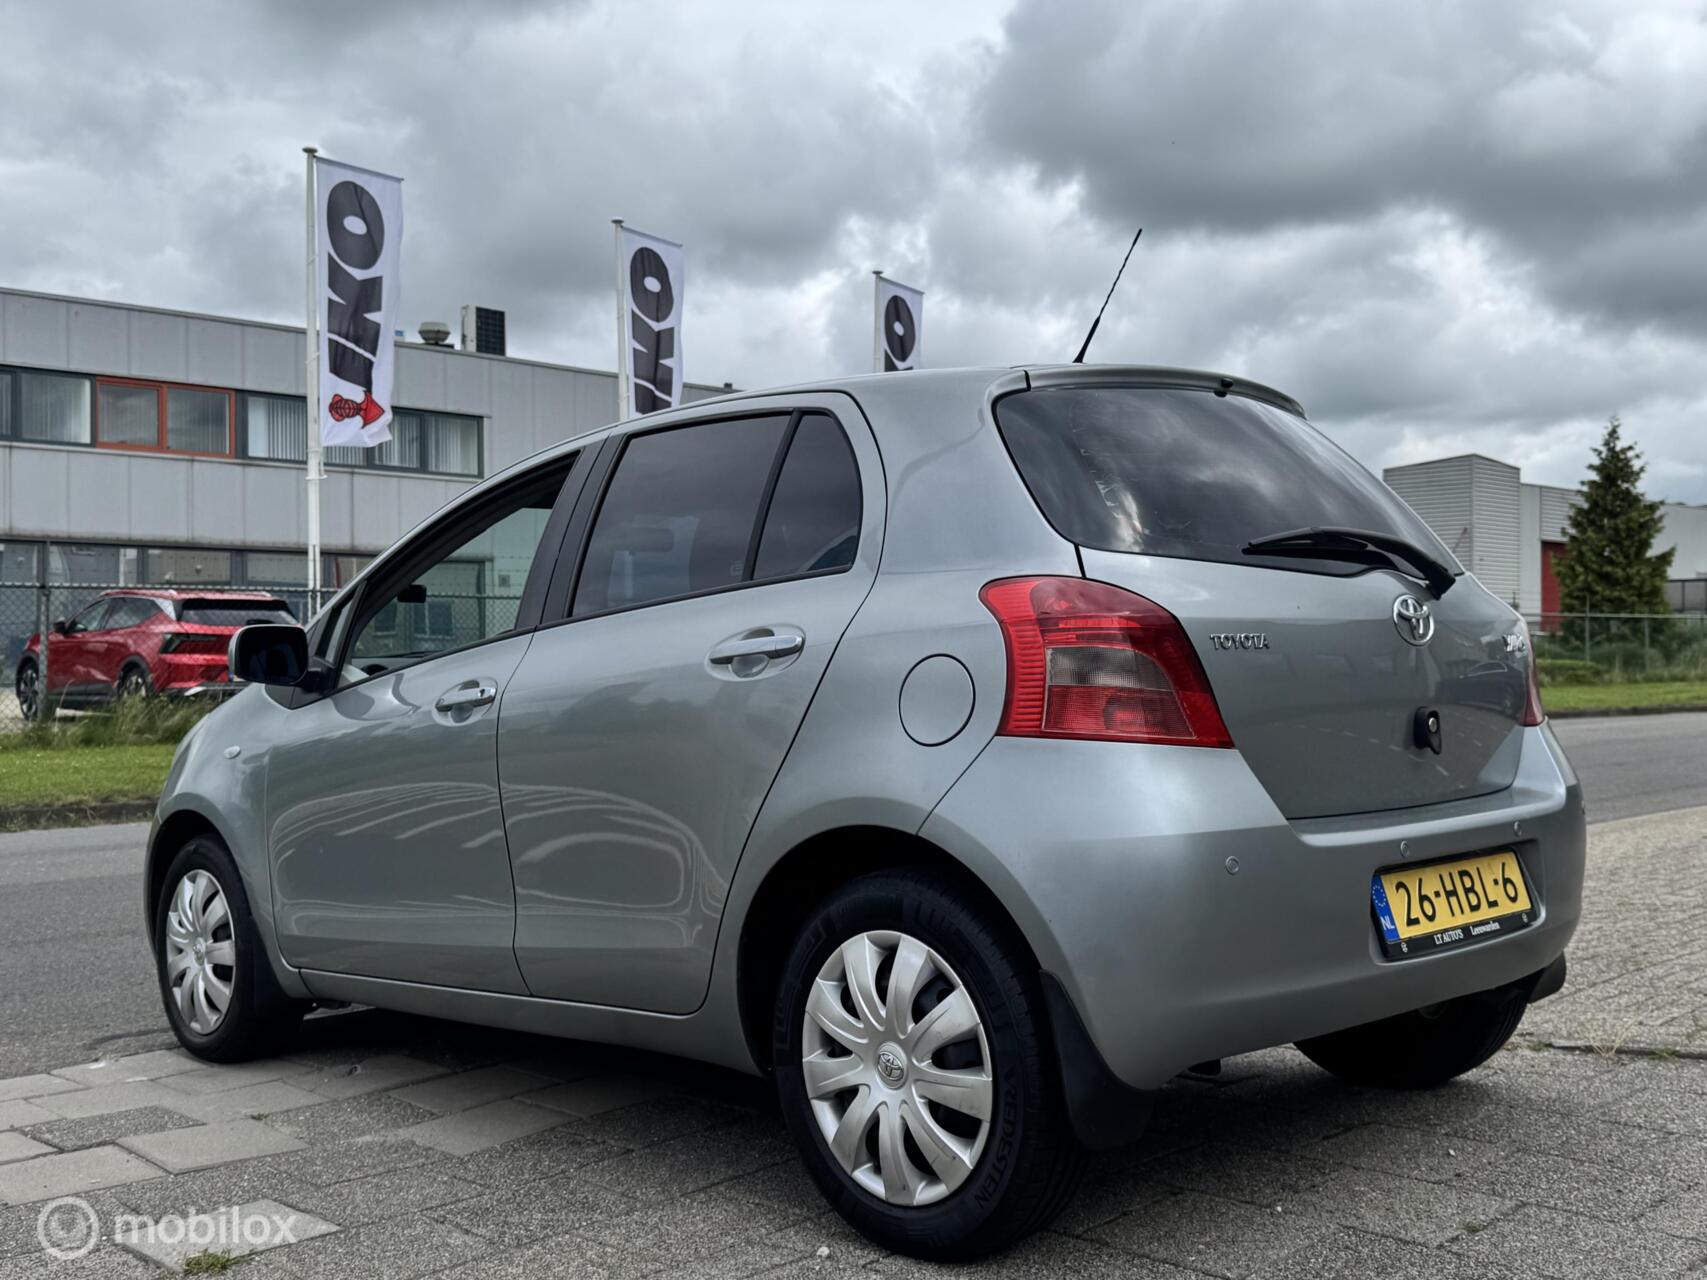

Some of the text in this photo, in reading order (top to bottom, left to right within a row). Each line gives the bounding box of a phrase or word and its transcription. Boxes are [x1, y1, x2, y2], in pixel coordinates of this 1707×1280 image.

[326, 180, 385, 391] IKO
[1209, 632, 1271, 650] TOYOTA
[1394, 861, 1519, 927] 26-HBL-6
[1380, 915, 1395, 931] NL
